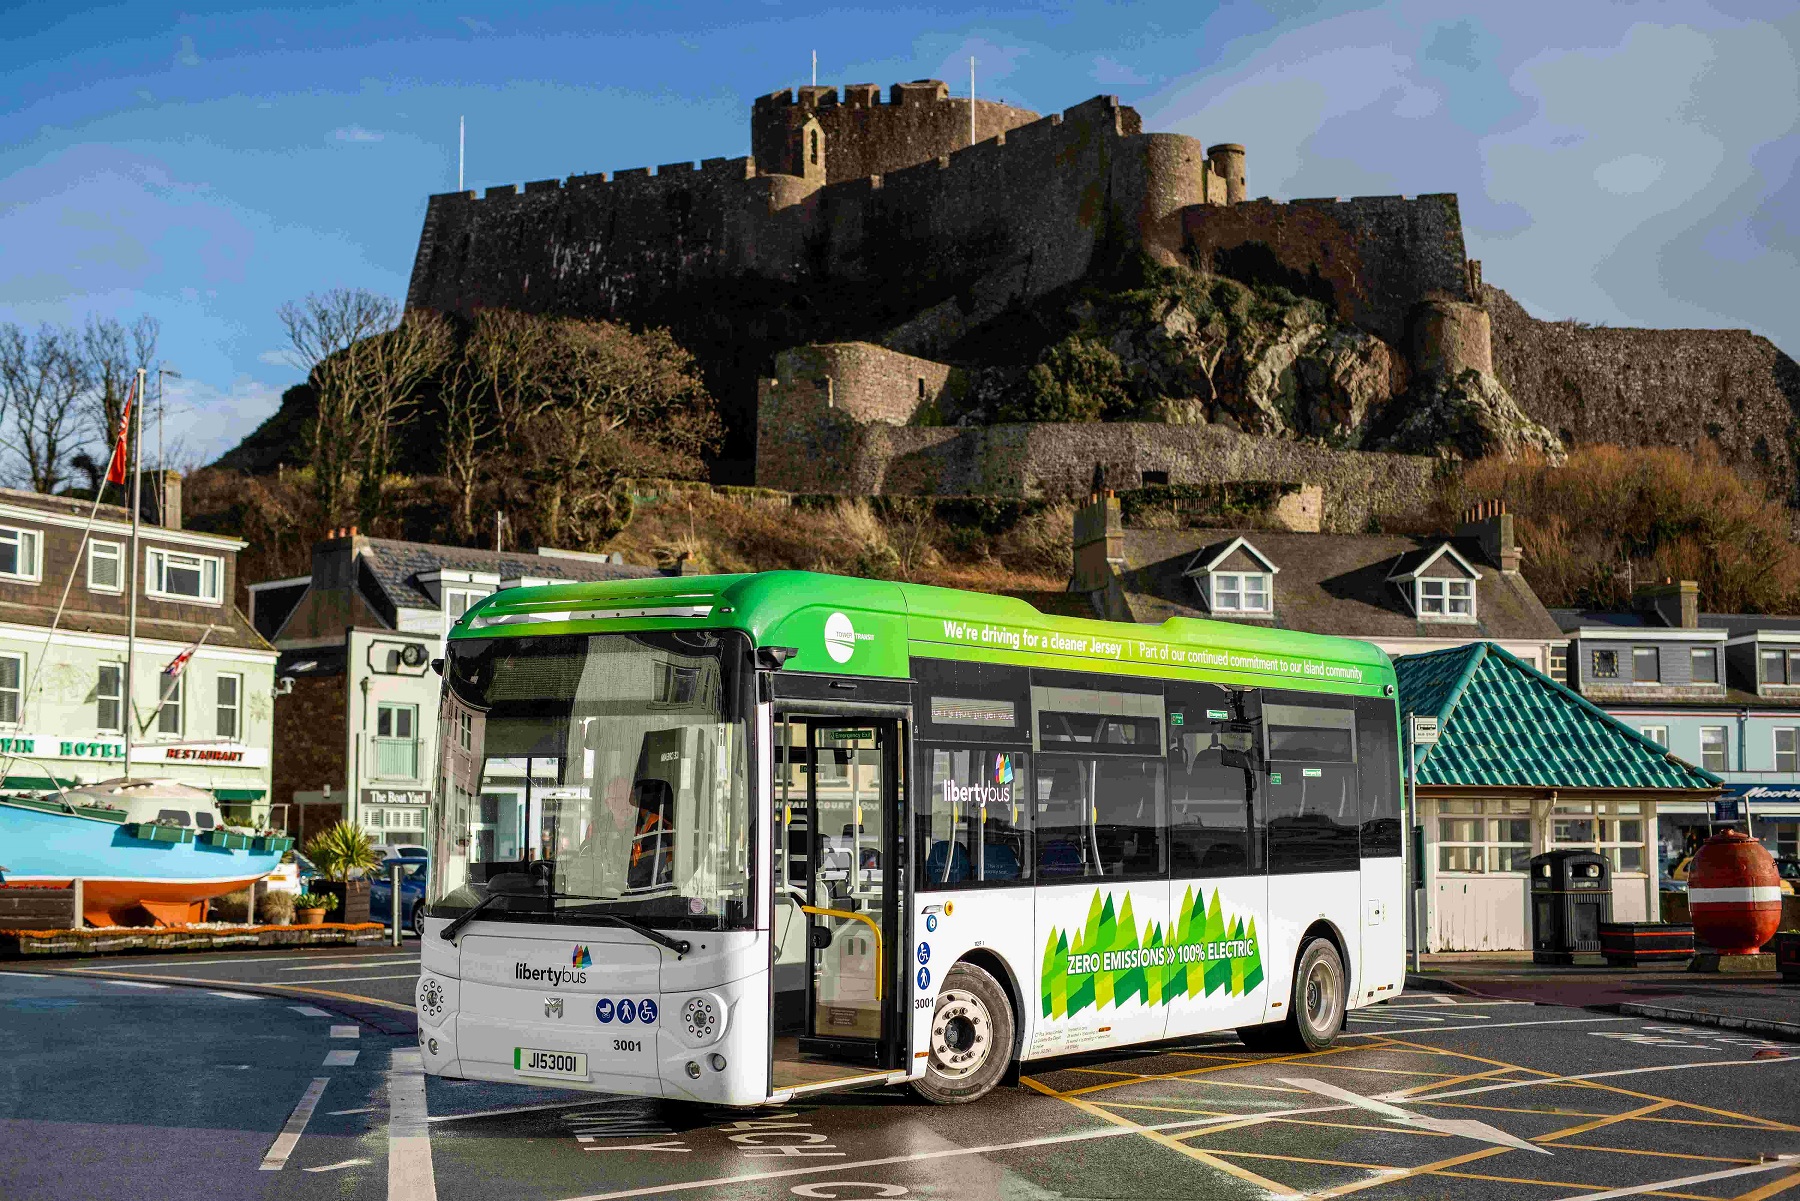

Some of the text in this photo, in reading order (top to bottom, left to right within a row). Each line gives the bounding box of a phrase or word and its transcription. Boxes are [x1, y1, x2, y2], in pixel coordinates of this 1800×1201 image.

[836, 631, 853, 639] TOWER
[943, 620, 1122, 659] We're driving for a cleaner Jersey
[1139, 641, 1363, 684] Part of our continued commitment to our Island community
[60, 741, 125, 758] HOTEL
[166, 748, 245, 762] RESTAURANT
[370, 791, 427, 804] The Boat Yard
[943, 779, 1010, 807] libertybus
[1067, 939, 1254, 975] ZERO EMISSIONS 100% ELECTRIC
[515, 962, 586, 987] libertybus
[915, 997, 934, 1010] 3001
[613, 1039, 642, 1052] 3001
[528, 1052, 577, 1072] J153001
